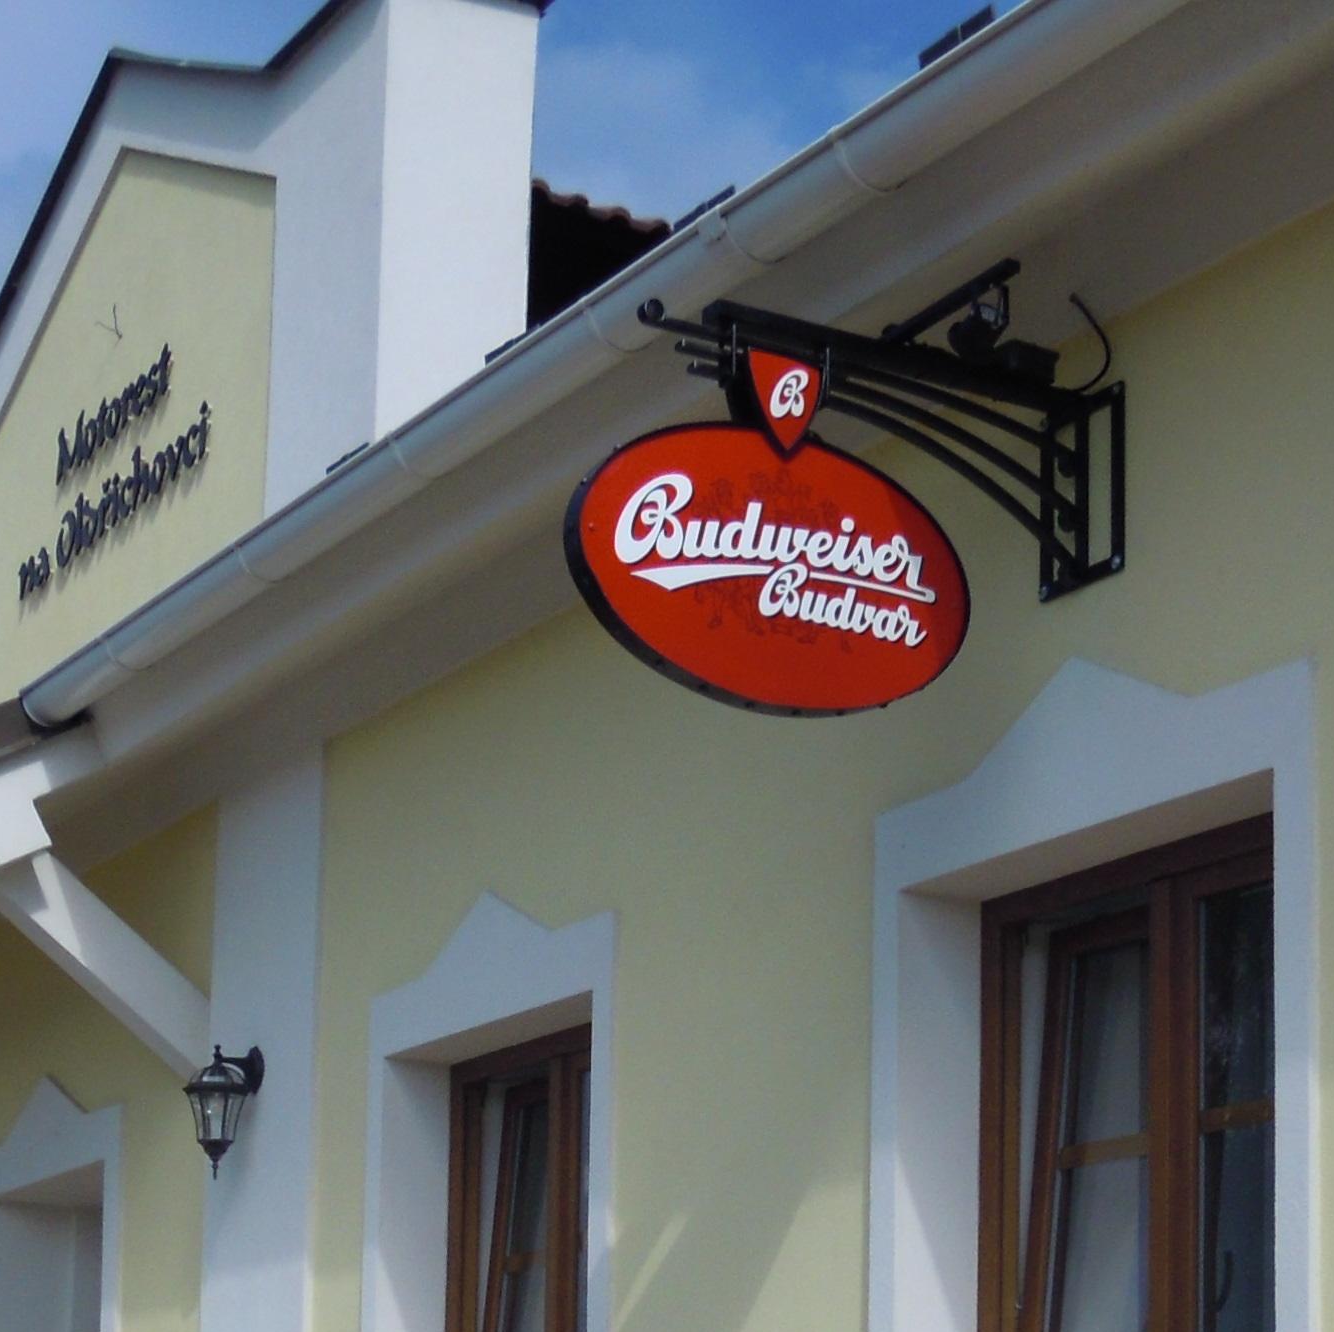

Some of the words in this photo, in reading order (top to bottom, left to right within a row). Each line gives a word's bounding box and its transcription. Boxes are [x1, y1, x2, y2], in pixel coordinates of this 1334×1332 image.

[55, 342, 172, 486] Motorest
[770, 368, 809, 419] B
[19, 546, 51, 600] na
[613, 472, 933, 600] Budweiser
[757, 562, 927, 647] Budvar
